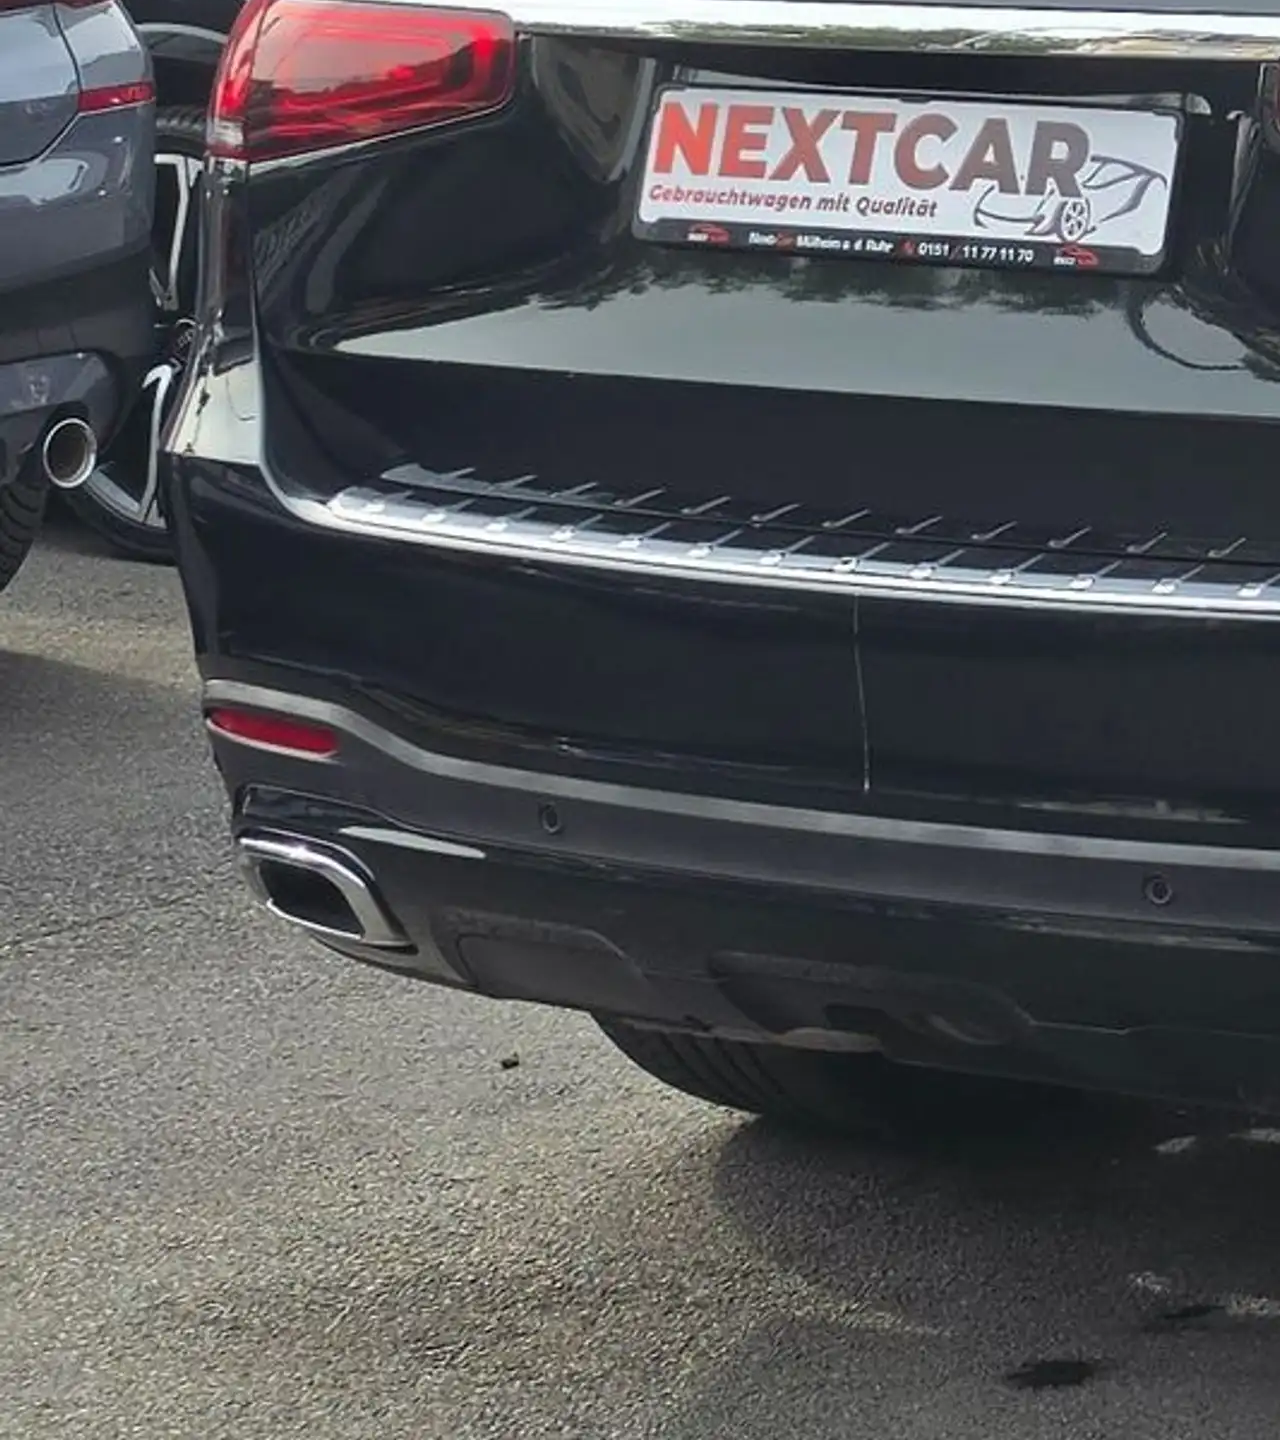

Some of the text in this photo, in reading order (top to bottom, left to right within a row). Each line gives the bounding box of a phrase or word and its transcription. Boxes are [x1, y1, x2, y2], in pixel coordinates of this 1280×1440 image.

[652, 100, 1090, 200] NEXTCAR
[648, 184, 938, 219] Gebrauchtwagen mit Qualität
[918, 242, 950, 256] 0151
